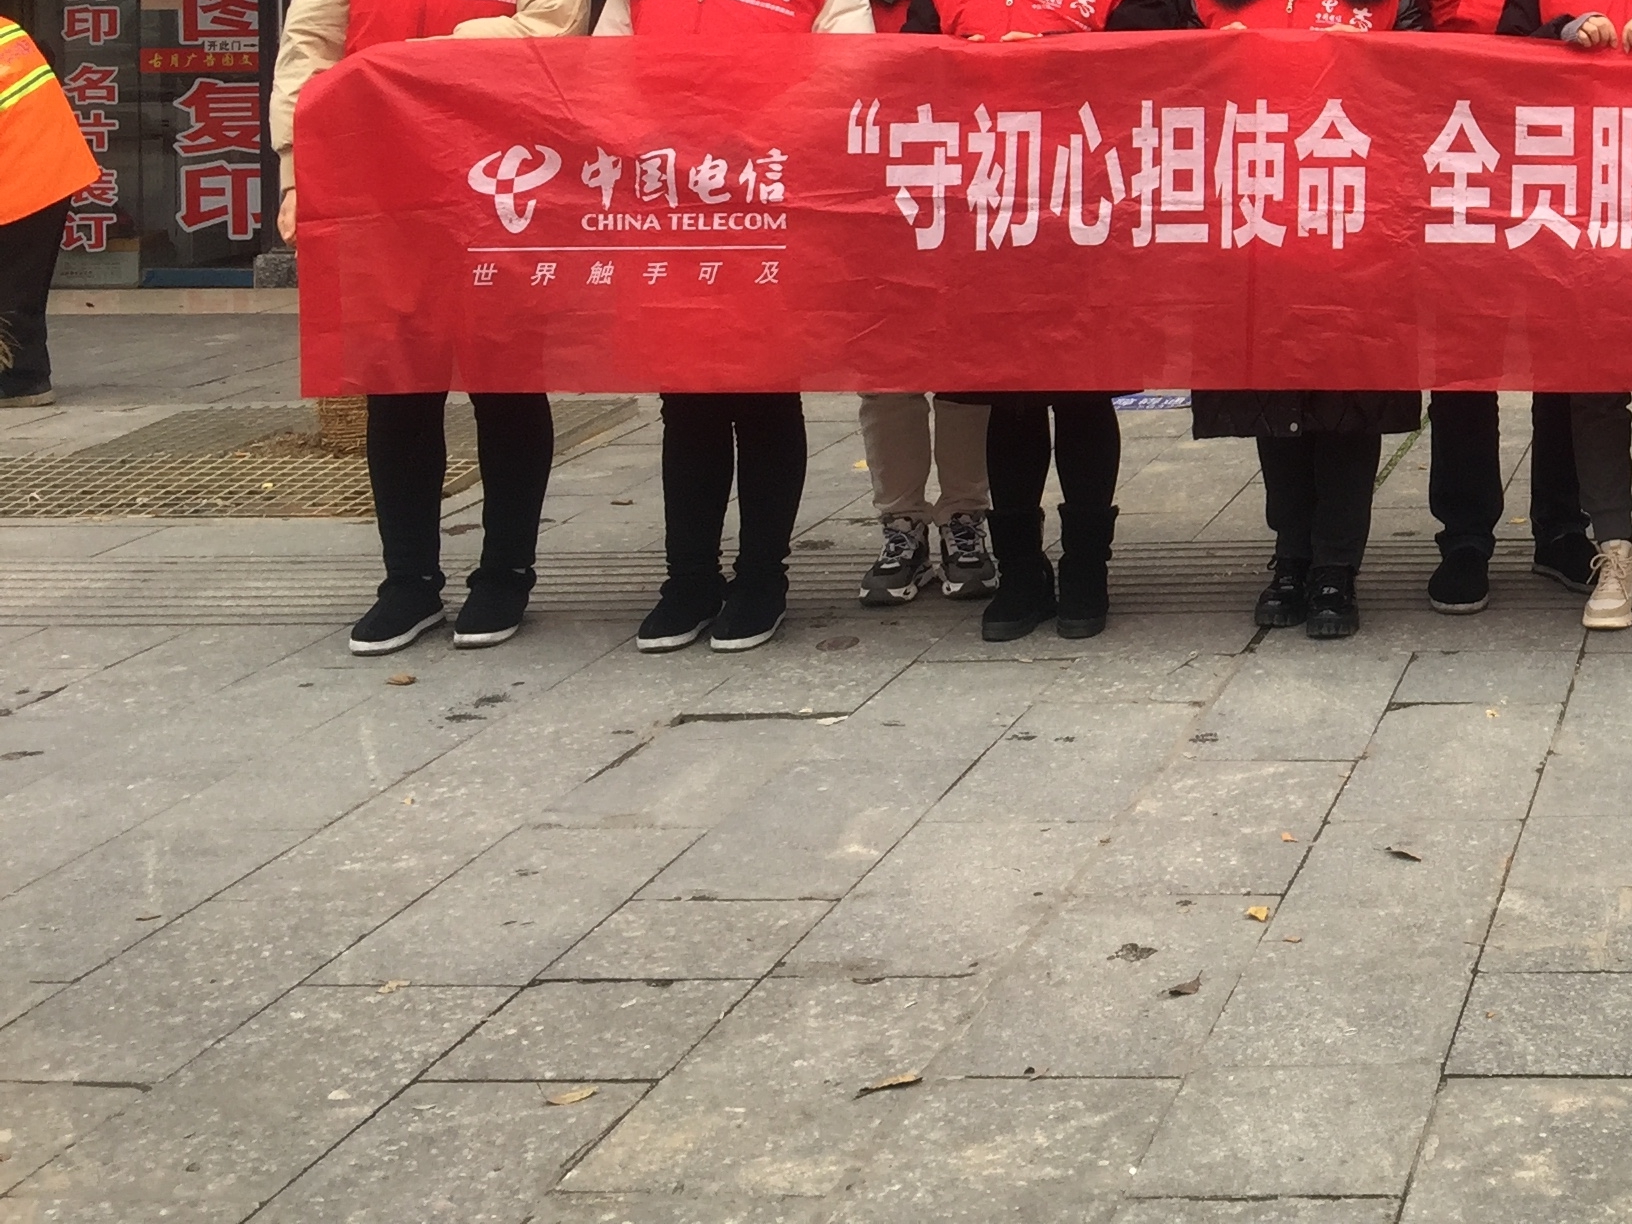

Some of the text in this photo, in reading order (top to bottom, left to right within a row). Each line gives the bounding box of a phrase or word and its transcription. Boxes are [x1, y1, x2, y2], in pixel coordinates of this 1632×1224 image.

[580, 146, 788, 206] 中国电信
[847, 97, 1371, 252] “守初心担使命
[580, 212, 788, 231] CHINA TELECOM
[471, 260, 781, 287] 世界触手可及
